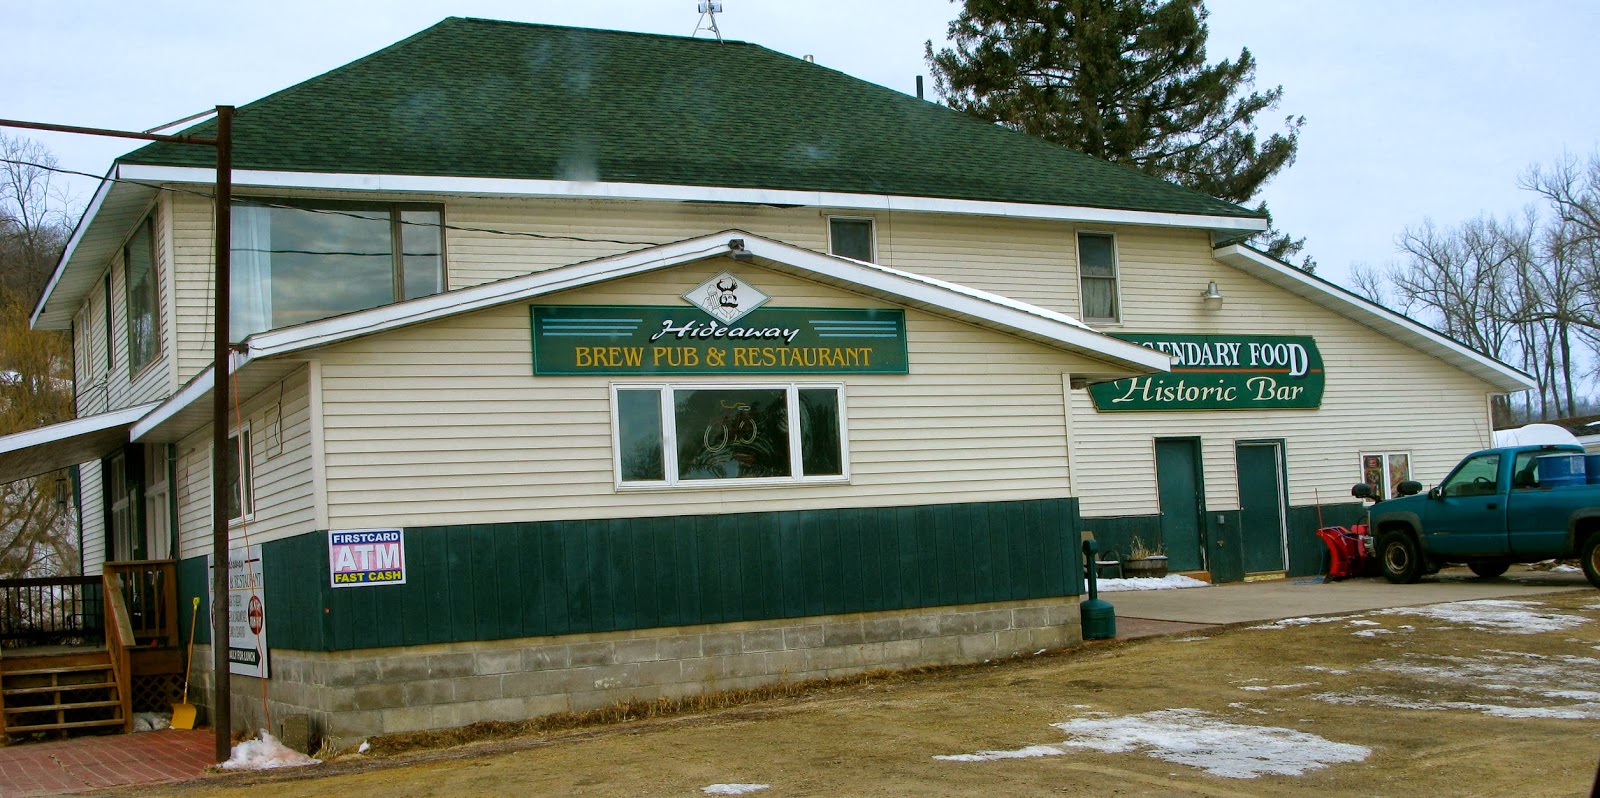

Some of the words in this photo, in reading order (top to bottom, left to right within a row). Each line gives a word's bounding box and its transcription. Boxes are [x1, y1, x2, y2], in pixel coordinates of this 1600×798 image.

[651, 319, 800, 343] Hideaway
[575, 347, 644, 366] BREW
[653, 346, 699, 366] PUB
[705, 348, 727, 367] &
[733, 347, 873, 367] RESTAURANT
[1248, 342, 1309, 376] FOOD
[1112, 376, 1237, 403] Historic
[1246, 376, 1304, 401] Bar
[333, 532, 399, 544] FIRSTCARD
[335, 543, 400, 572] ATM
[335, 572, 365, 583] FAST
[368, 571, 402, 581] CASH
